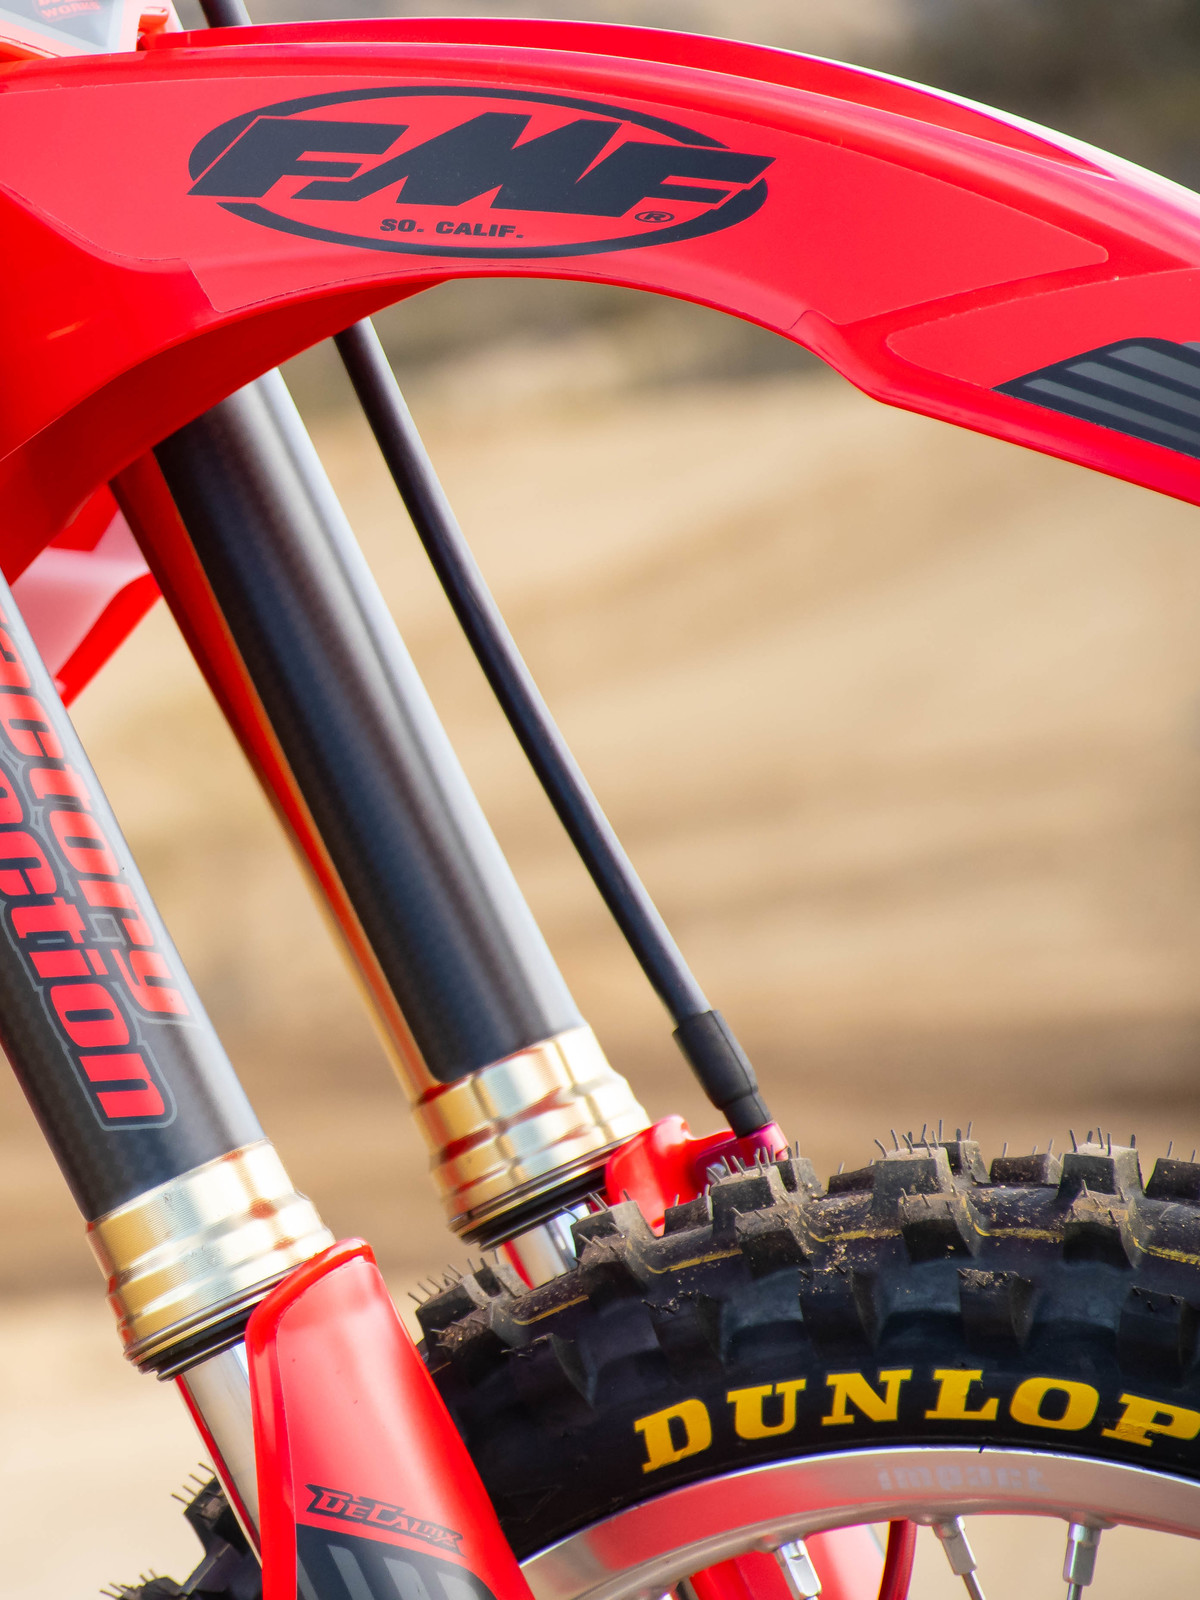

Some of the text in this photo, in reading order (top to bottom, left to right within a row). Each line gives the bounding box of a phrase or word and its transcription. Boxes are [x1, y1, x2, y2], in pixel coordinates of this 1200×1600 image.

[187, 112, 776, 218] FMF
[379, 218, 525, 239] SO. CALIF.
[634, 1369, 1200, 1474] DUNLOP
